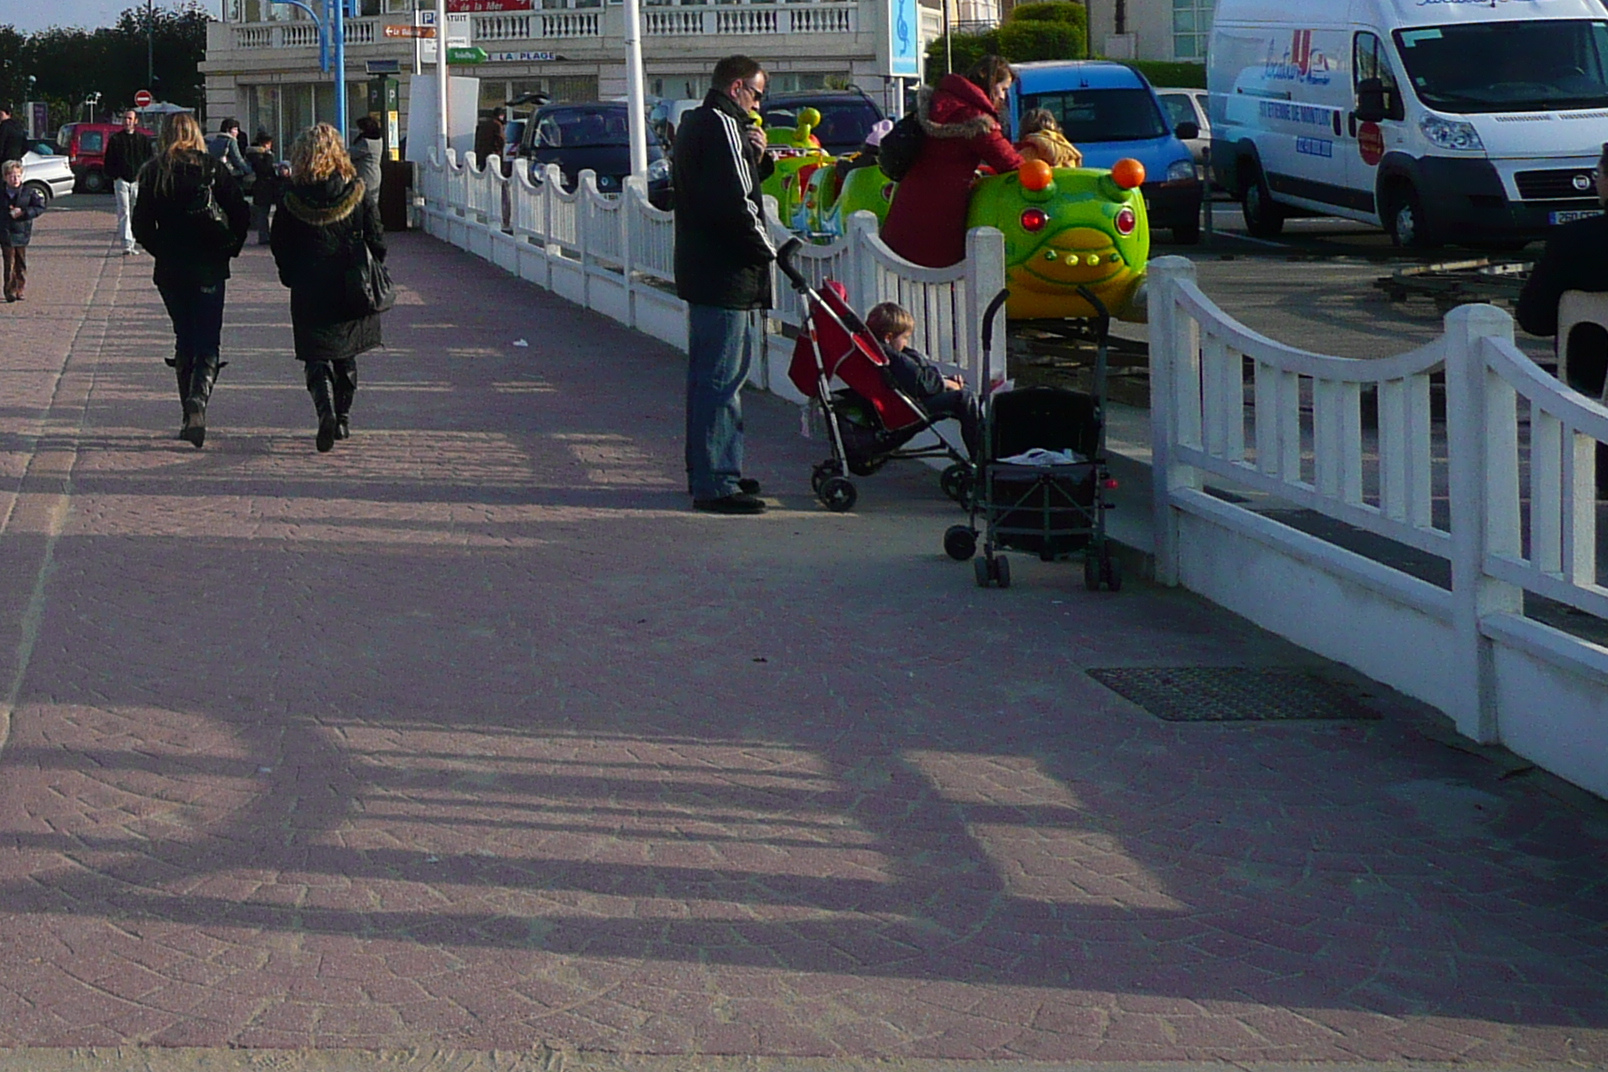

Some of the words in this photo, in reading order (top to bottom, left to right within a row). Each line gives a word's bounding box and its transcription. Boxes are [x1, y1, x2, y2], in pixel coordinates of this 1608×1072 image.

[486, 1, 504, 11] Mer
[499, 53, 513, 61] LA
[520, 52, 555, 60] PLAGE
